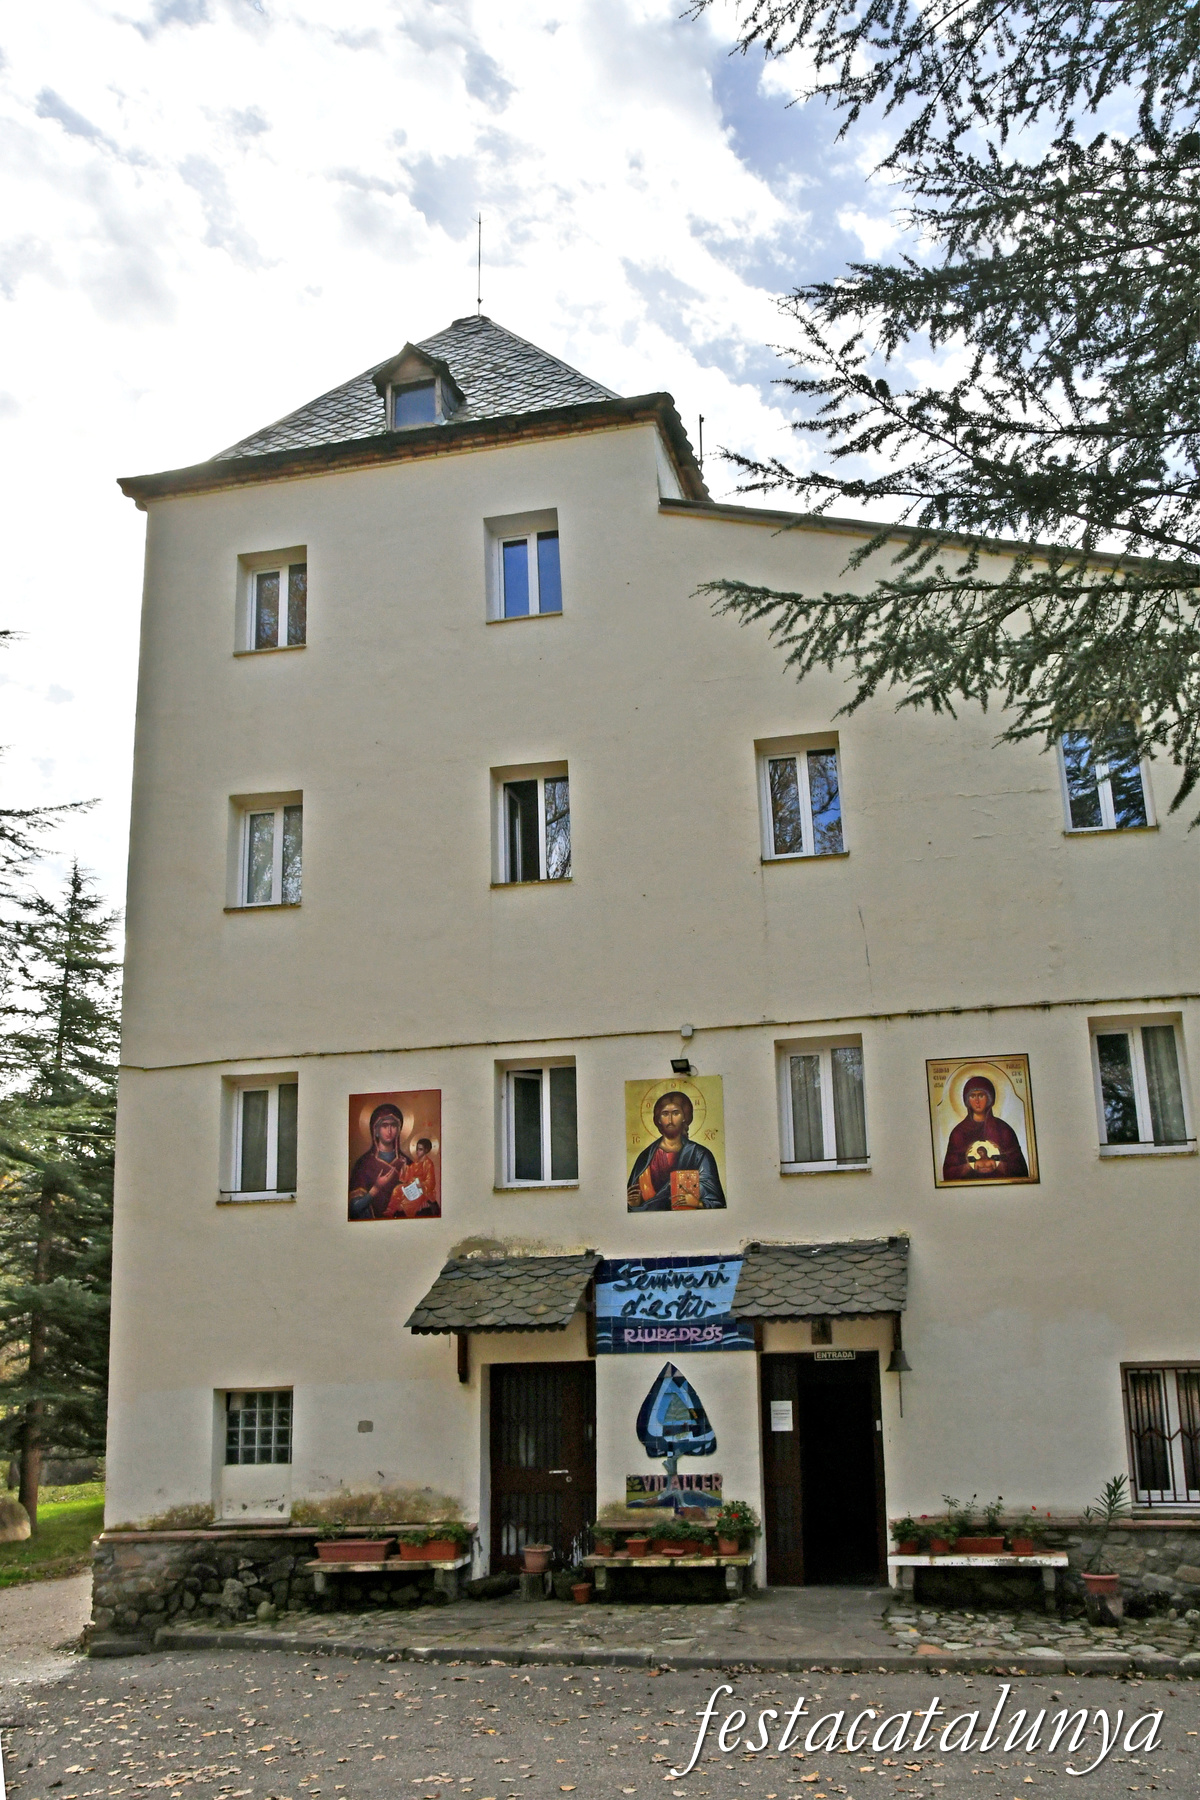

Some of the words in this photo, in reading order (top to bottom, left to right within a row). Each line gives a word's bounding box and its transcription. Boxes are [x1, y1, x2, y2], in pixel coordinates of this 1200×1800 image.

[613, 1262, 731, 1293] Seminari
[816, 1351, 854, 1359] ENTRADA
[642, 1473, 723, 1491] VILALLER
